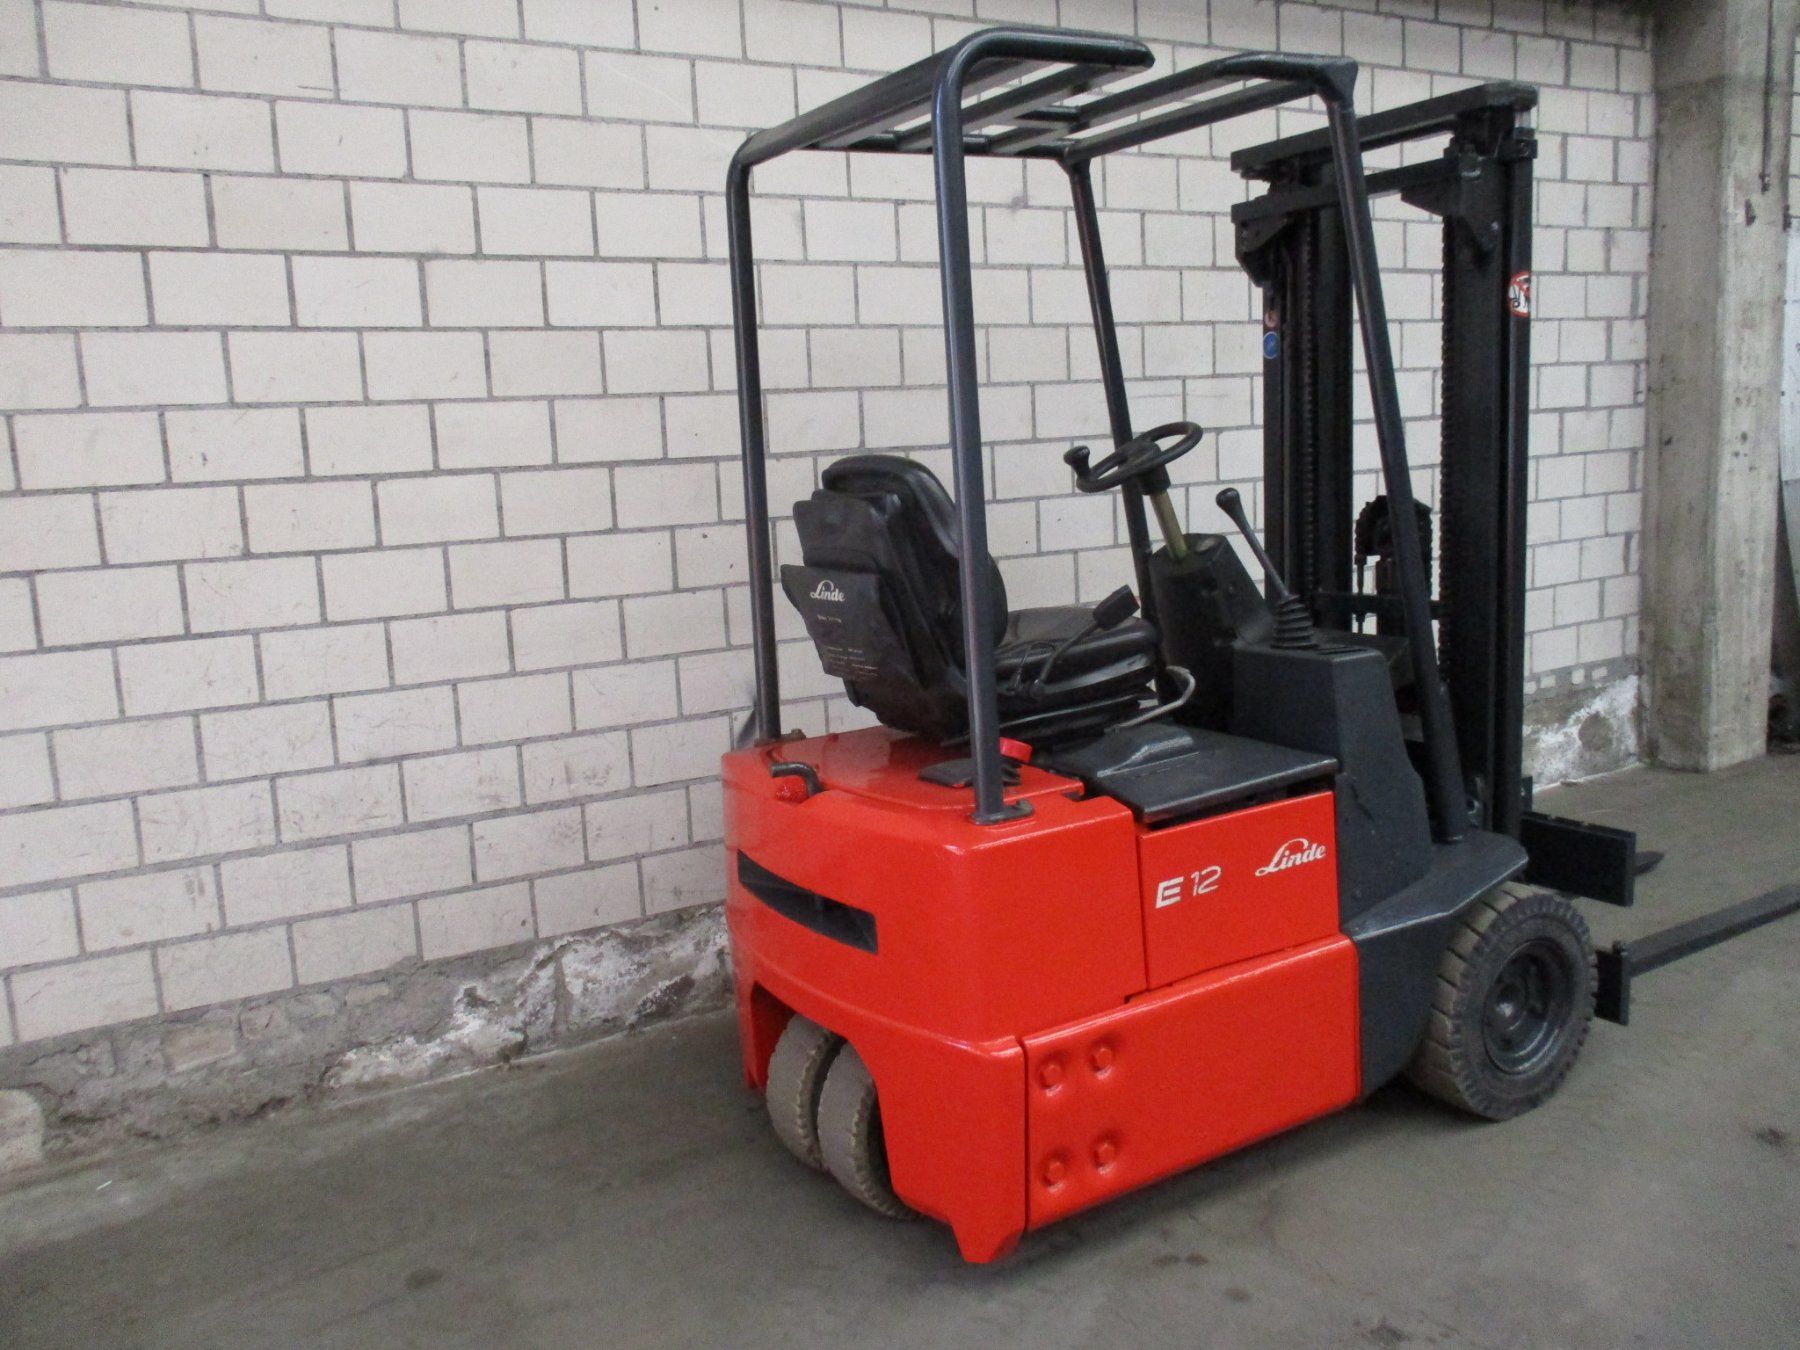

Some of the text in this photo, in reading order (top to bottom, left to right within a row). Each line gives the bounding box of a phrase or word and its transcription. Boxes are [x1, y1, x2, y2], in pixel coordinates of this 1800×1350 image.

[810, 579, 846, 601] Linde
[1254, 838, 1327, 877] Linde
[1155, 865, 1222, 909] E 12
